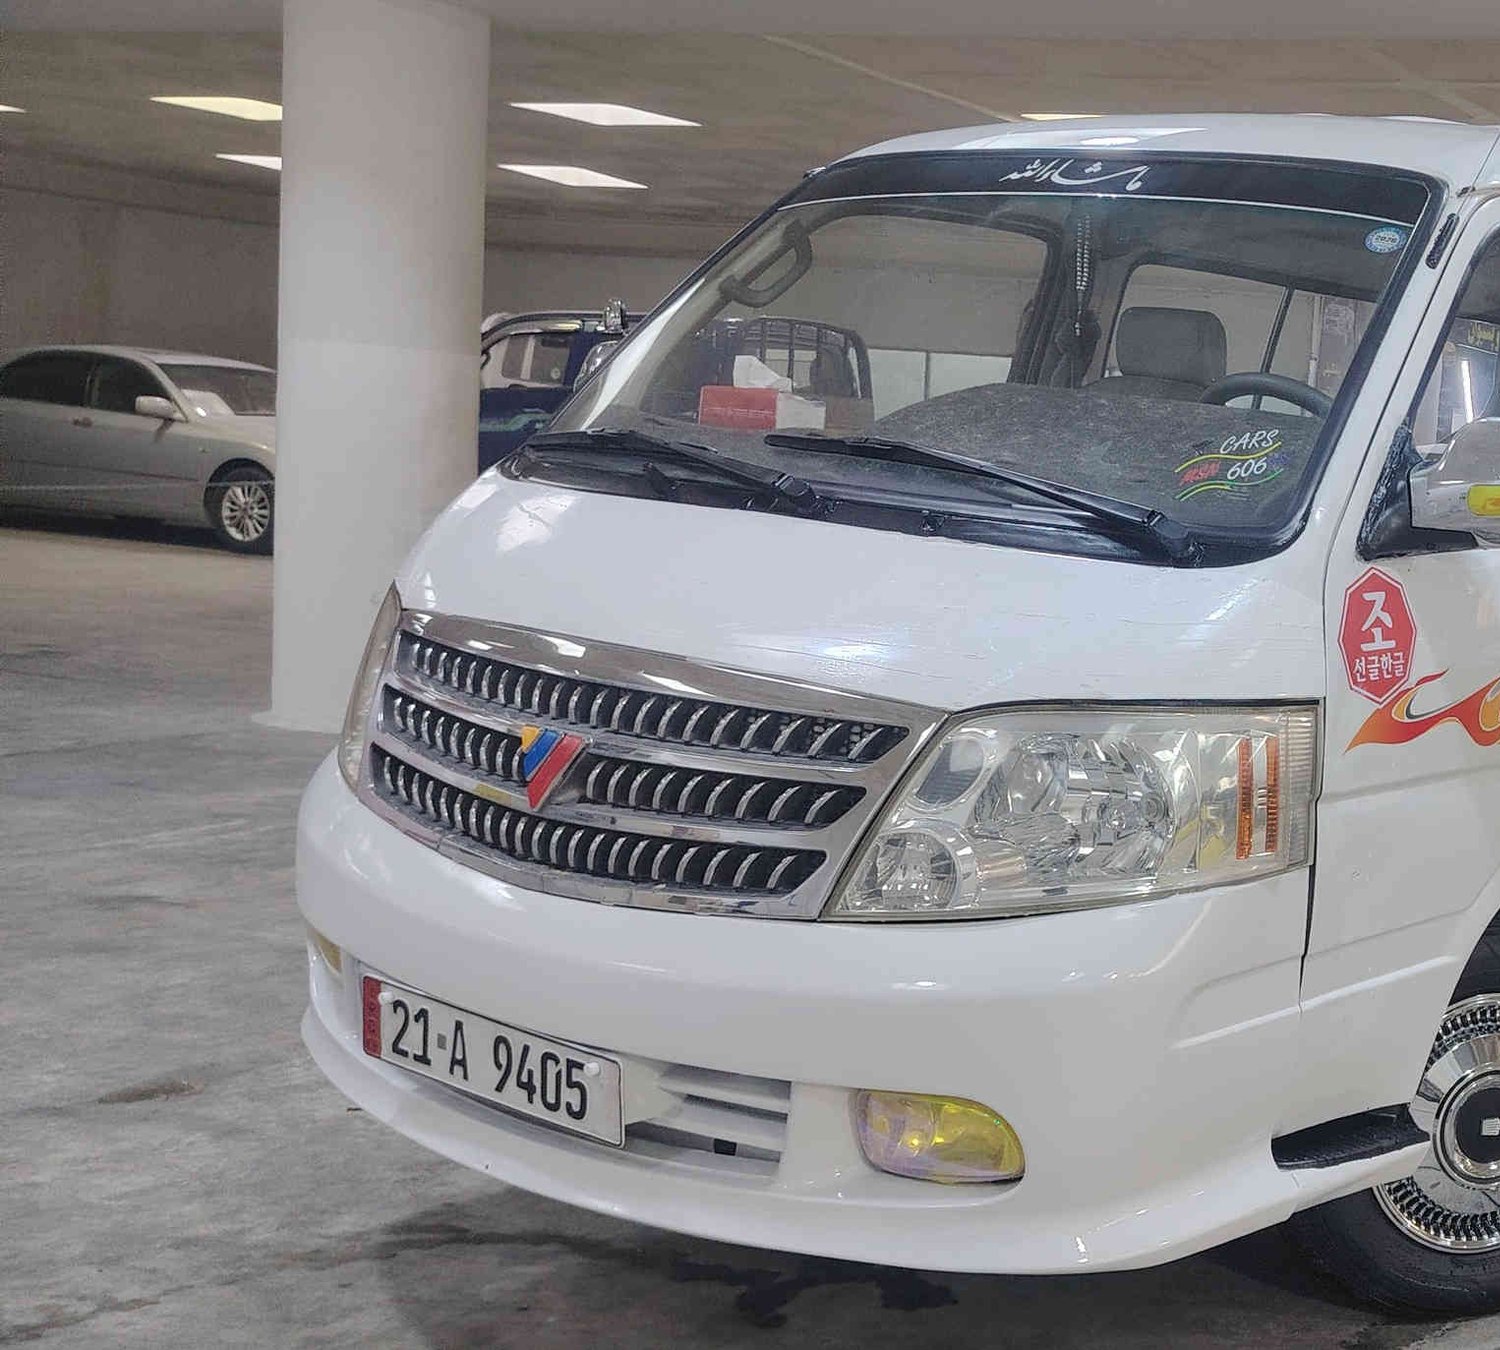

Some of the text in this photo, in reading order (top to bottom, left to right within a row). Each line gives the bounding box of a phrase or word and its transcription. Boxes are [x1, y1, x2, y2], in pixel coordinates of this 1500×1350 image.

[1220, 430, 1279, 454] CARS
[1226, 457, 1267, 480] 606
[1360, 591, 1397, 652] 조
[493, 1035, 588, 1120] 9405
